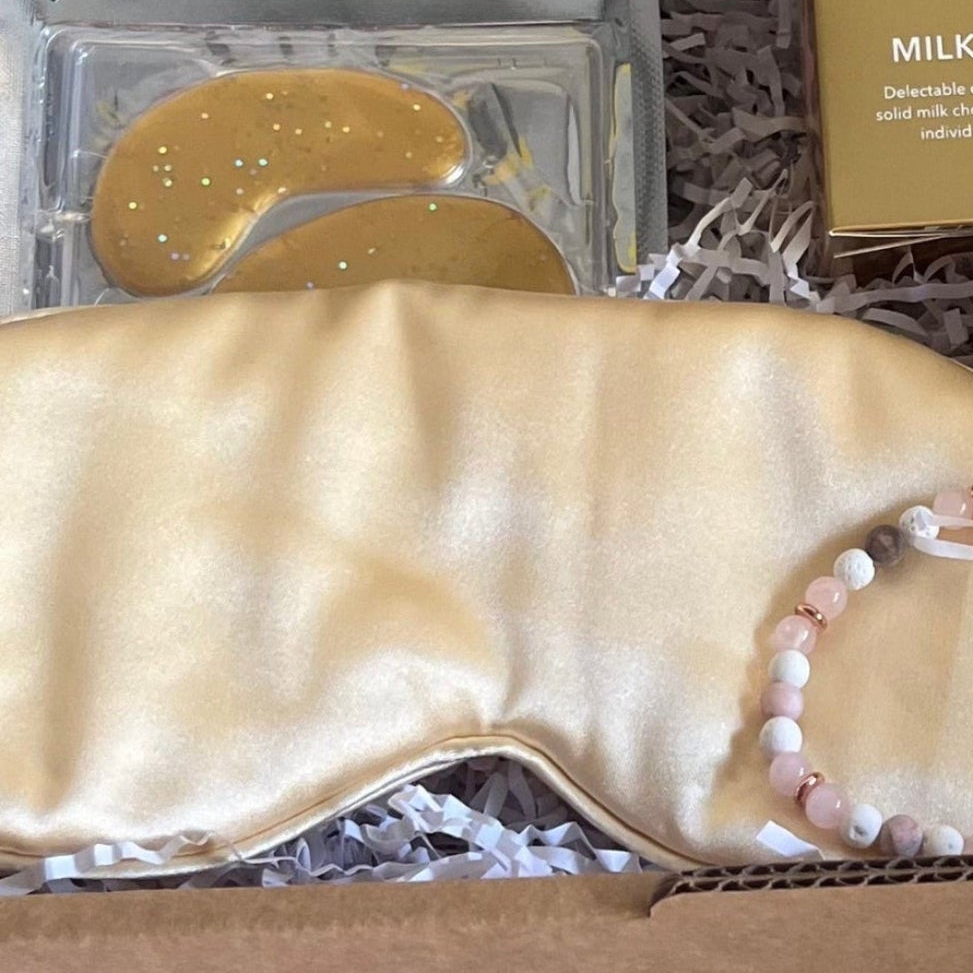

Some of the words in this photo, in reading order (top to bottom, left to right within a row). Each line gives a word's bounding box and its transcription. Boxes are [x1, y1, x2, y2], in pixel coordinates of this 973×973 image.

[884, 81, 966, 100] Delectable
[876, 105, 912, 122] solid
[916, 103, 949, 119] milk
